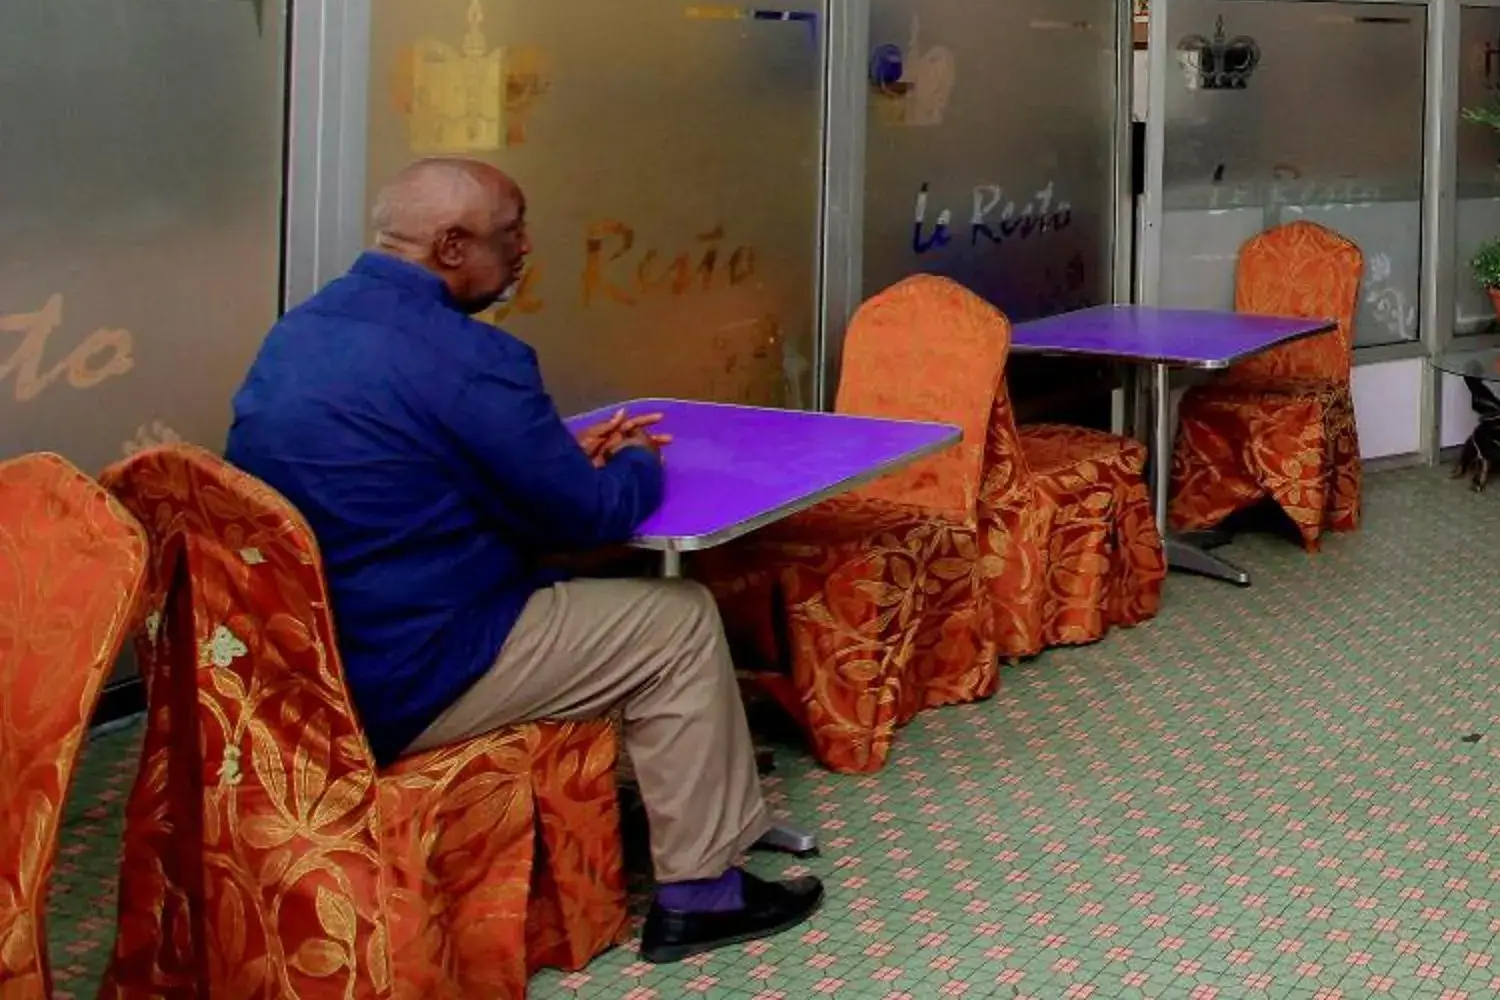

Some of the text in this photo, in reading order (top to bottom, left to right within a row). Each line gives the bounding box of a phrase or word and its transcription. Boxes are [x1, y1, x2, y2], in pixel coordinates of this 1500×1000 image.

[913, 180, 1072, 254] Le Resto
[0, 292, 134, 402] to
